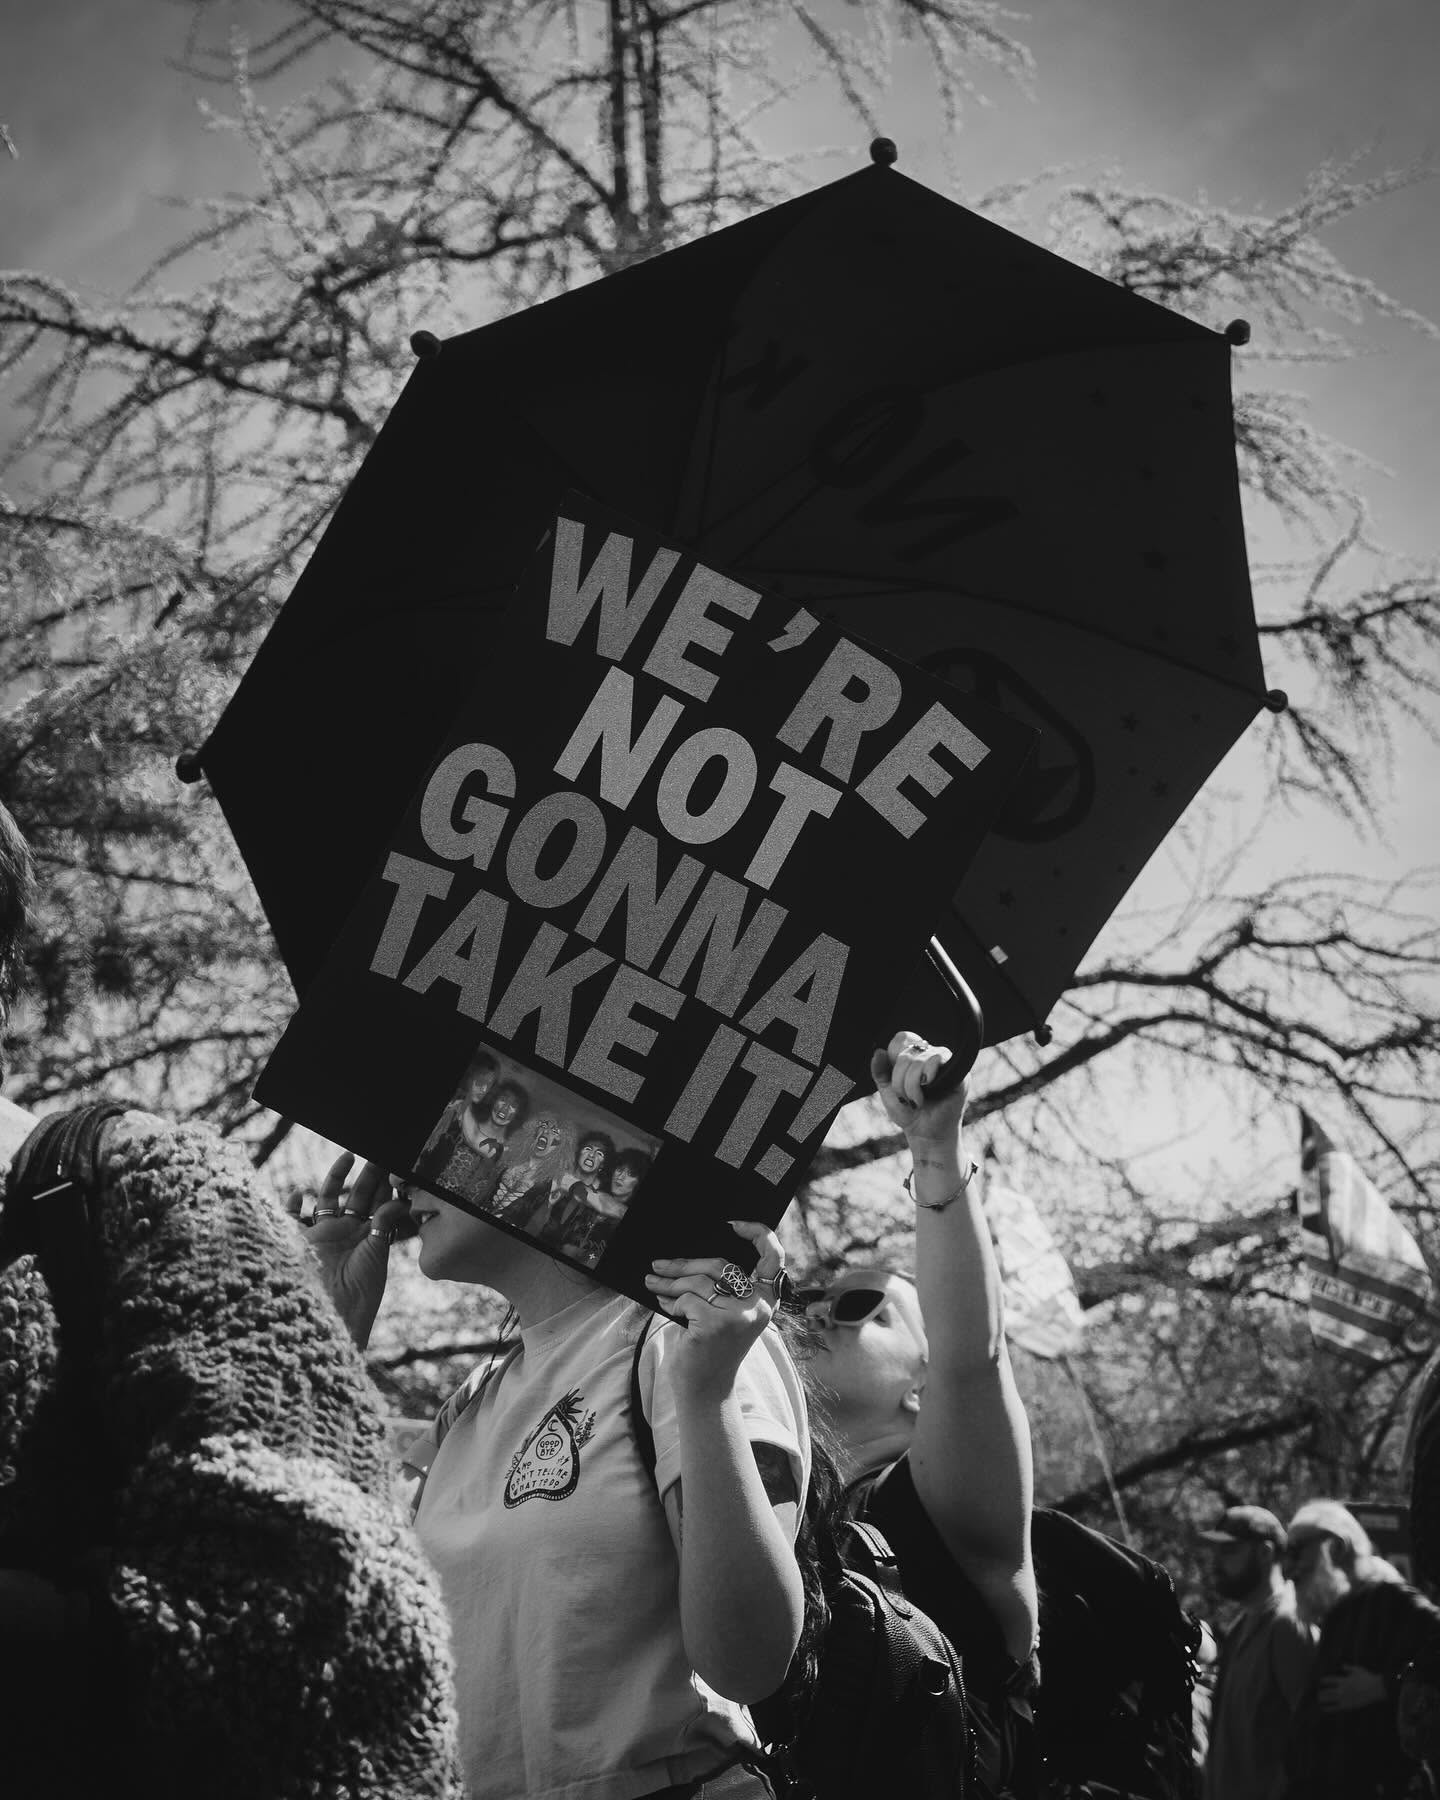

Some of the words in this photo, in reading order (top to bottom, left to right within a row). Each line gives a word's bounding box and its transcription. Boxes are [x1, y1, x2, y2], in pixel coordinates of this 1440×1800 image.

[546, 517, 991, 839] WE'RE
[553, 665, 843, 890] NOT
[420, 743, 851, 1067] GONNA
[369, 851, 687, 1104] TAKE
[663, 1024, 856, 1186] IT!
[537, 1468, 556, 1476] TELL
[556, 1468, 569, 1479] ME
[539, 1440, 560, 1448] GOOD
[539, 1447, 555, 1456] BYE
[549, 1478, 560, 1488] DO
